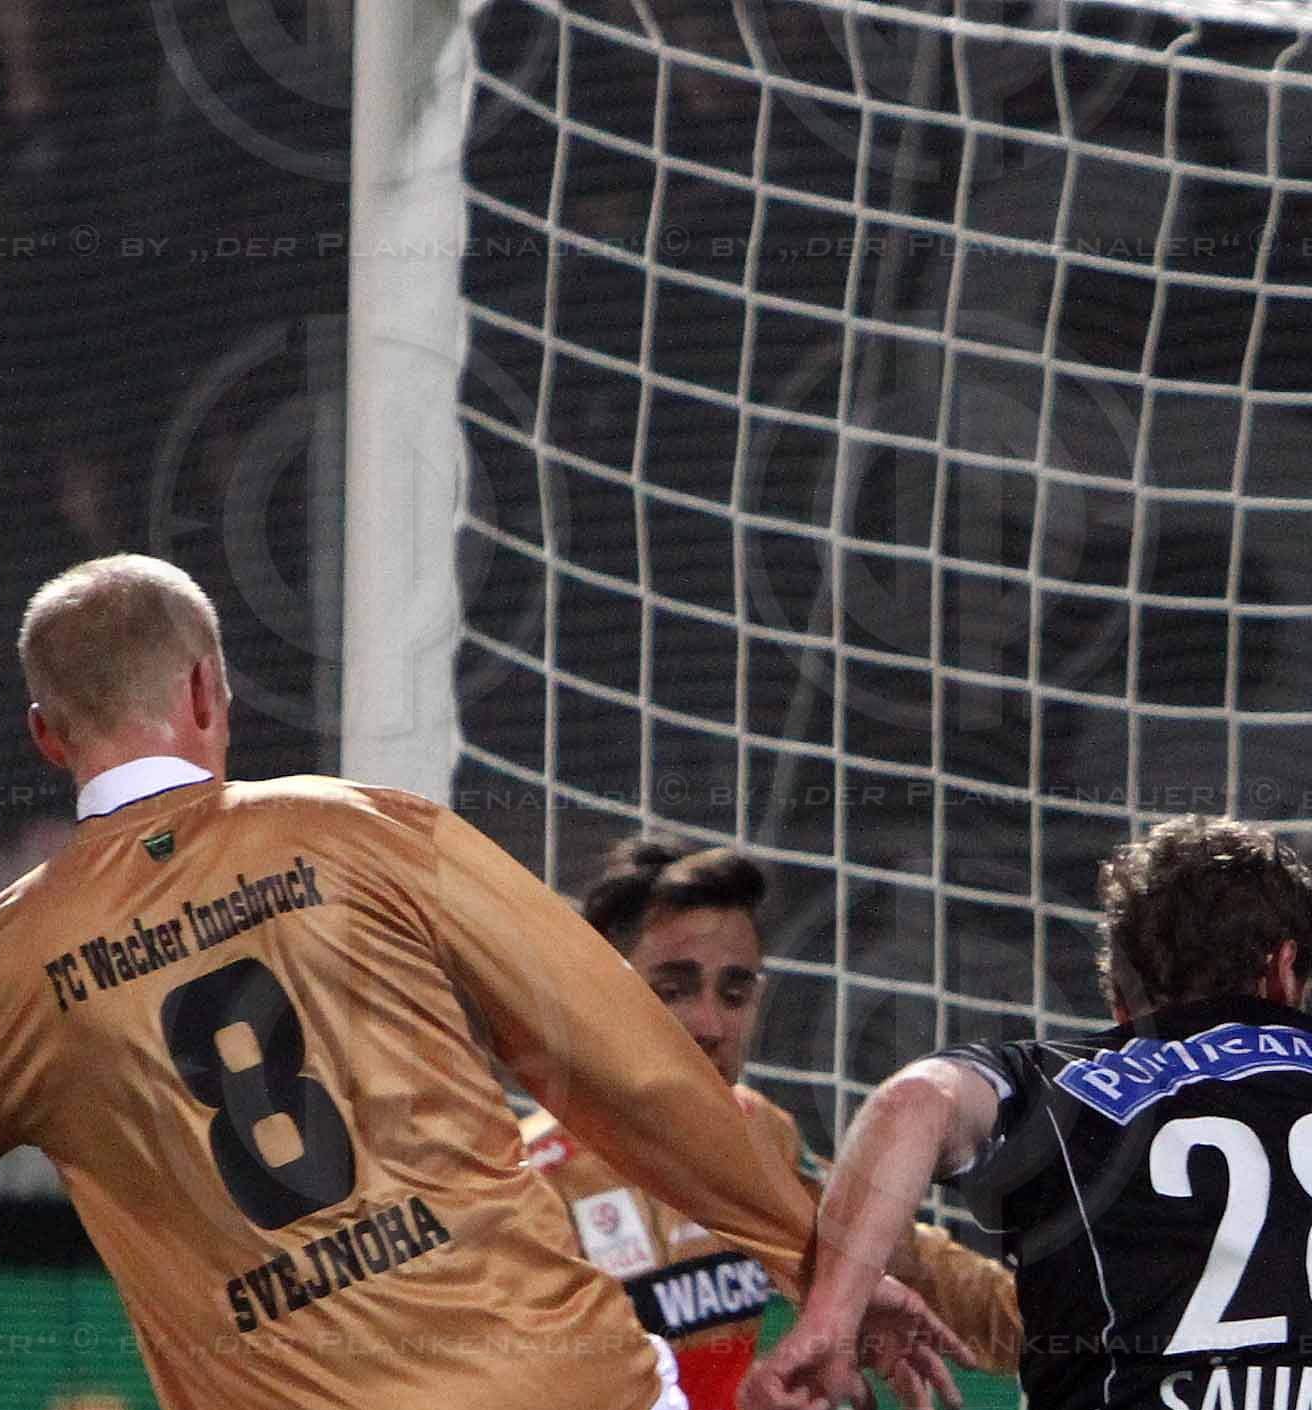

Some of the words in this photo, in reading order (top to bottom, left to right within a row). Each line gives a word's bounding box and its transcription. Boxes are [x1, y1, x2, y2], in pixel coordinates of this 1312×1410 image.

[44, 953, 87, 1013] FC
[80, 917, 190, 990] Wacker
[182, 856, 322, 950] Innsbruck
[160, 957, 356, 1231] 8
[226, 1196, 451, 1332] SVEJNOHA
